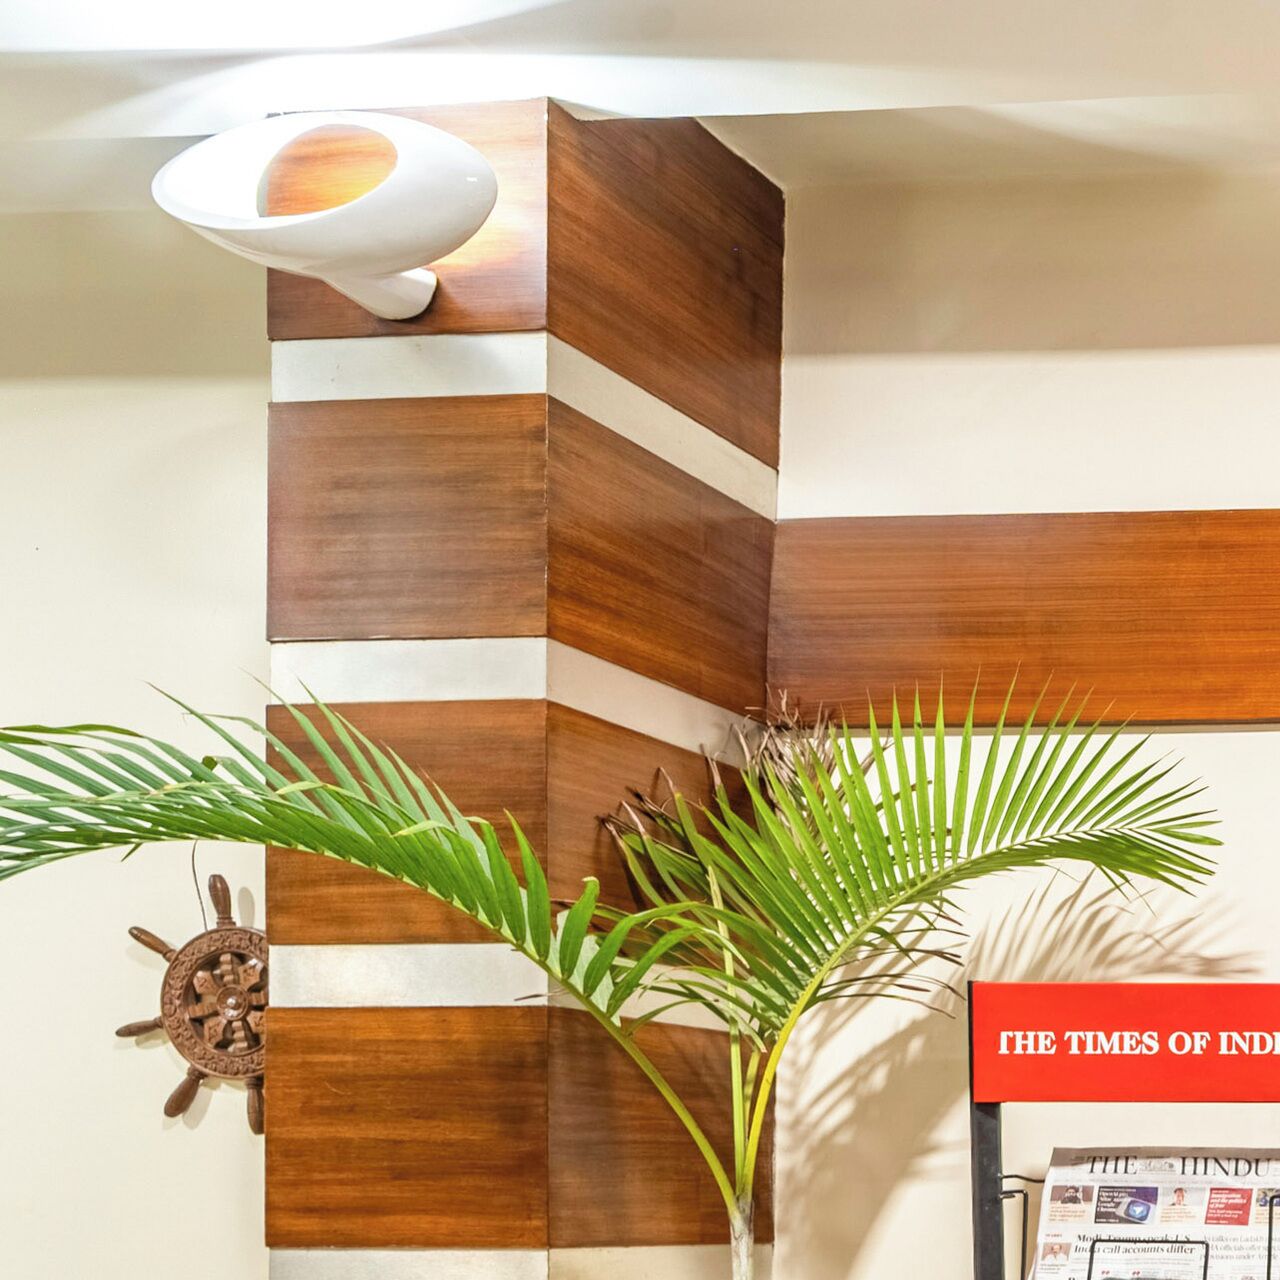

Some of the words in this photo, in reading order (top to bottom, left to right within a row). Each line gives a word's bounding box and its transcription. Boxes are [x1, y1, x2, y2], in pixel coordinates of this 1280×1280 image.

[1064, 1031, 1160, 1055] TIMES
[1168, 1031, 1211, 1055] OF
[1087, 1155, 1138, 1175] THE
[1180, 1156, 1272, 1177] HINDU
[1102, 1245, 1120, 1254] call
[1122, 1246, 1164, 1254] accounts
[1166, 1245, 1195, 1254] differ
